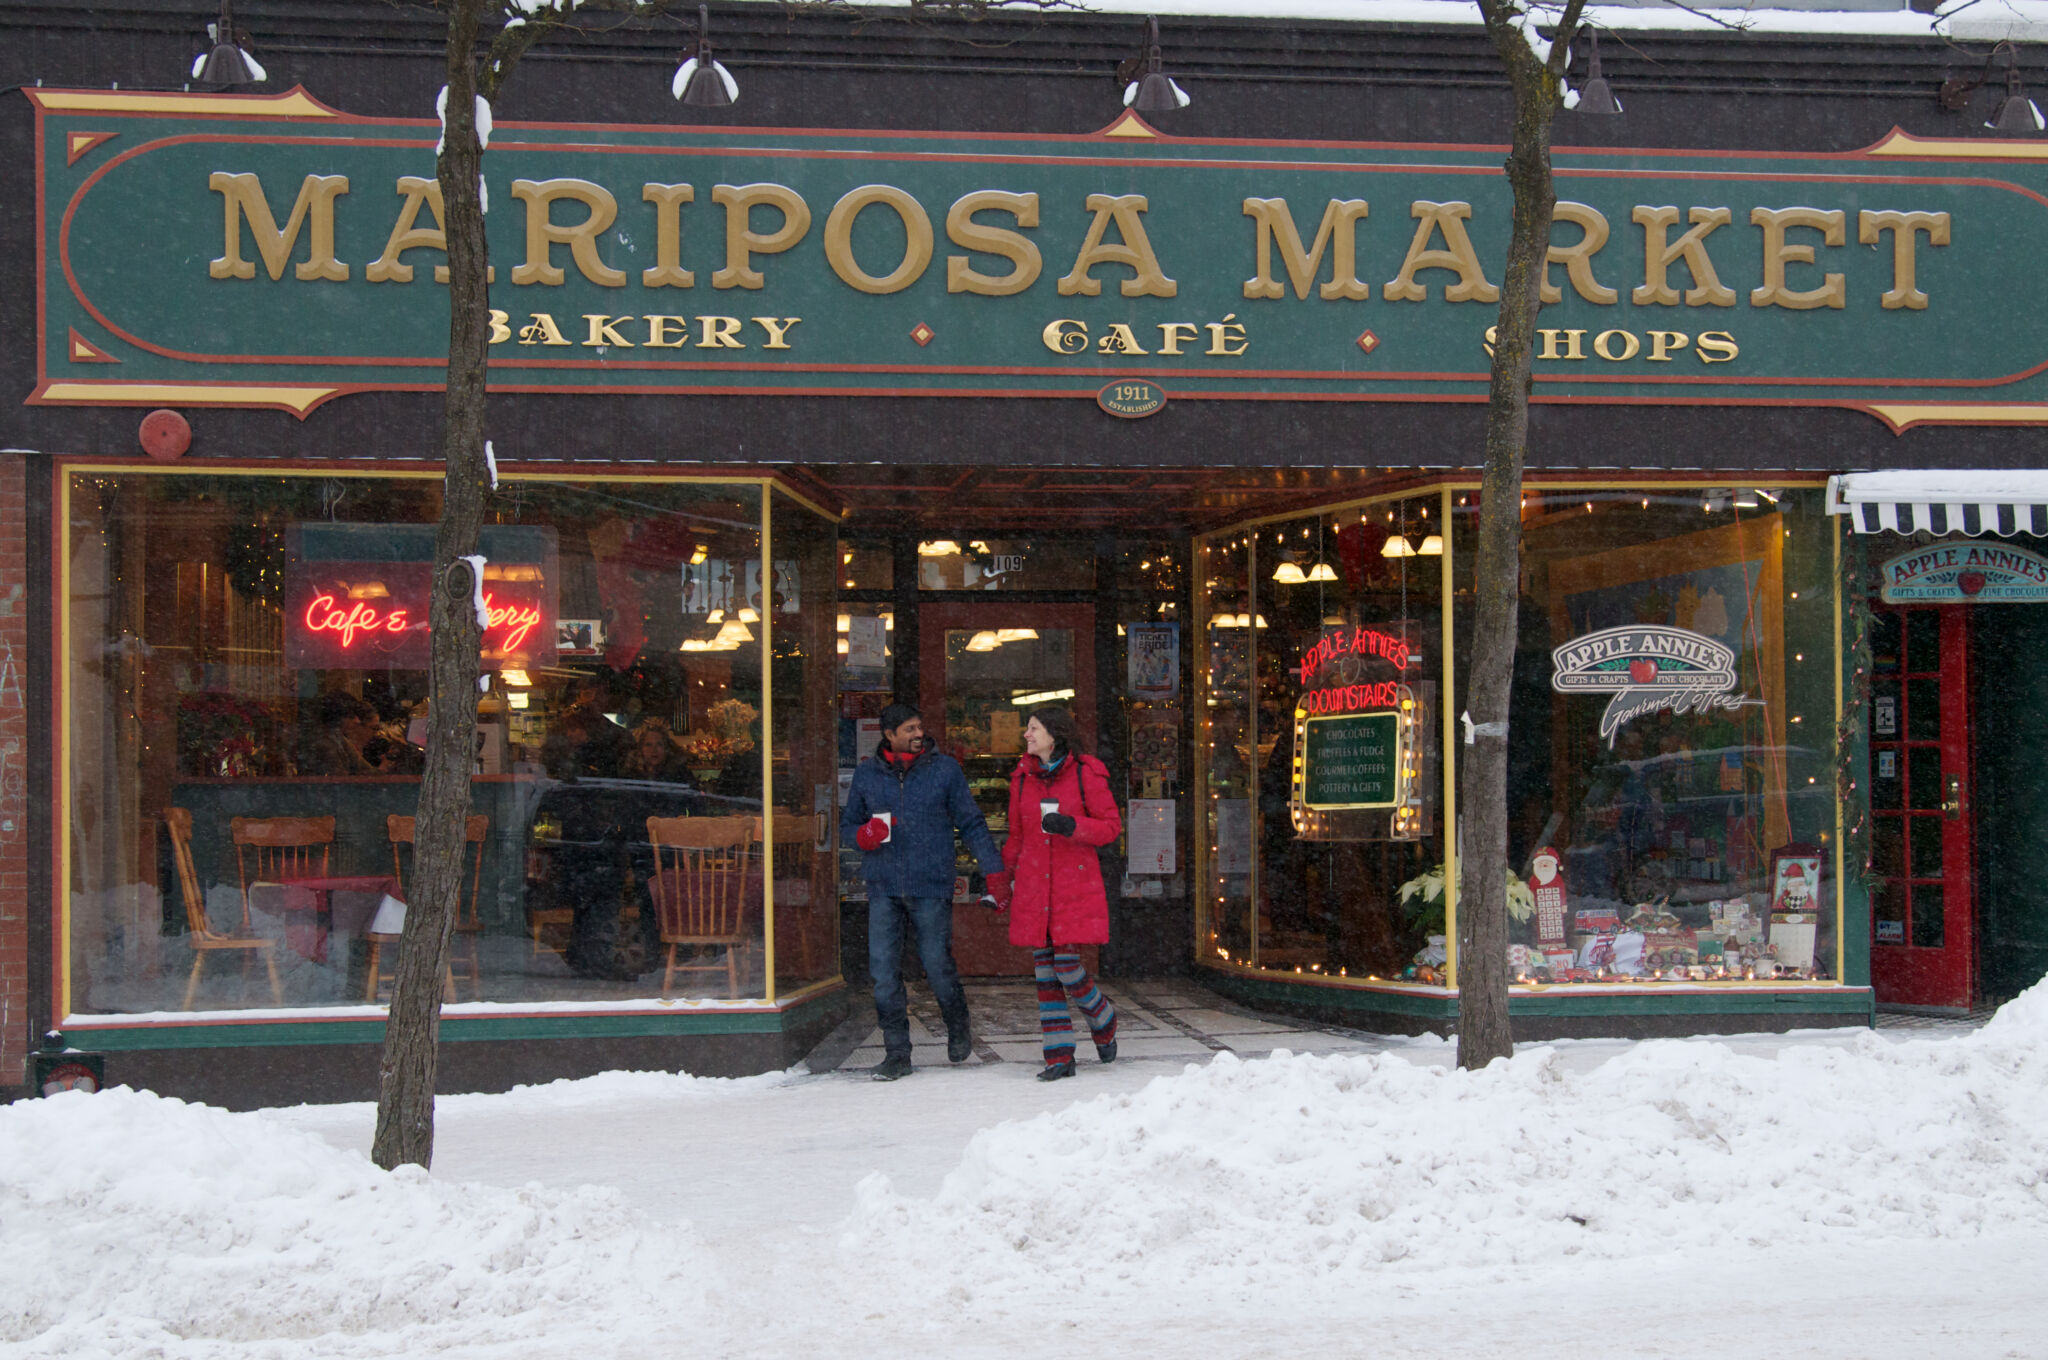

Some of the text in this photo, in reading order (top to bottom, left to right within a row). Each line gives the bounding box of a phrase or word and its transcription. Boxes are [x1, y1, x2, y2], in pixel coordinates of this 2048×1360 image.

[208, 171, 1951, 310] MARIPOSA MARKET
[1042, 313, 1250, 356] CAFÉ
[1114, 386, 1150, 401] 1911
[1108, 400, 1158, 412] ESTABLISHED
[997, 556, 1021, 571] 109
[1894, 548, 2047, 585] APPLE ANNIE'S
[1892, 588, 1915, 597] GIFTS
[1926, 588, 1956, 597] CRAFTS
[1984, 588, 2001, 597] FINE
[306, 596, 382, 648] Cafe
[1300, 631, 1347, 685] APPLE
[1566, 634, 1727, 672] APPLE ANNIE'S
[1565, 675, 1588, 684] GIFTS
[1599, 675, 1629, 684] CRAFTS
[1657, 675, 1676, 684] FINE
[1679, 674, 1726, 684] CHOCOLATE
[1309, 681, 1398, 713] DOWNSTAIRS
[1600, 680, 1767, 750] Gourmet Coffees
[1326, 727, 1375, 741] CHOCOLATES
[1317, 746, 1351, 759] TRUFFLES
[1360, 745, 1385, 756] FUDGE
[1315, 764, 1386, 776] GOURMET COFFEES
[1318, 783, 1350, 794] POTTERY
[1359, 782, 1382, 792] GIFTS
